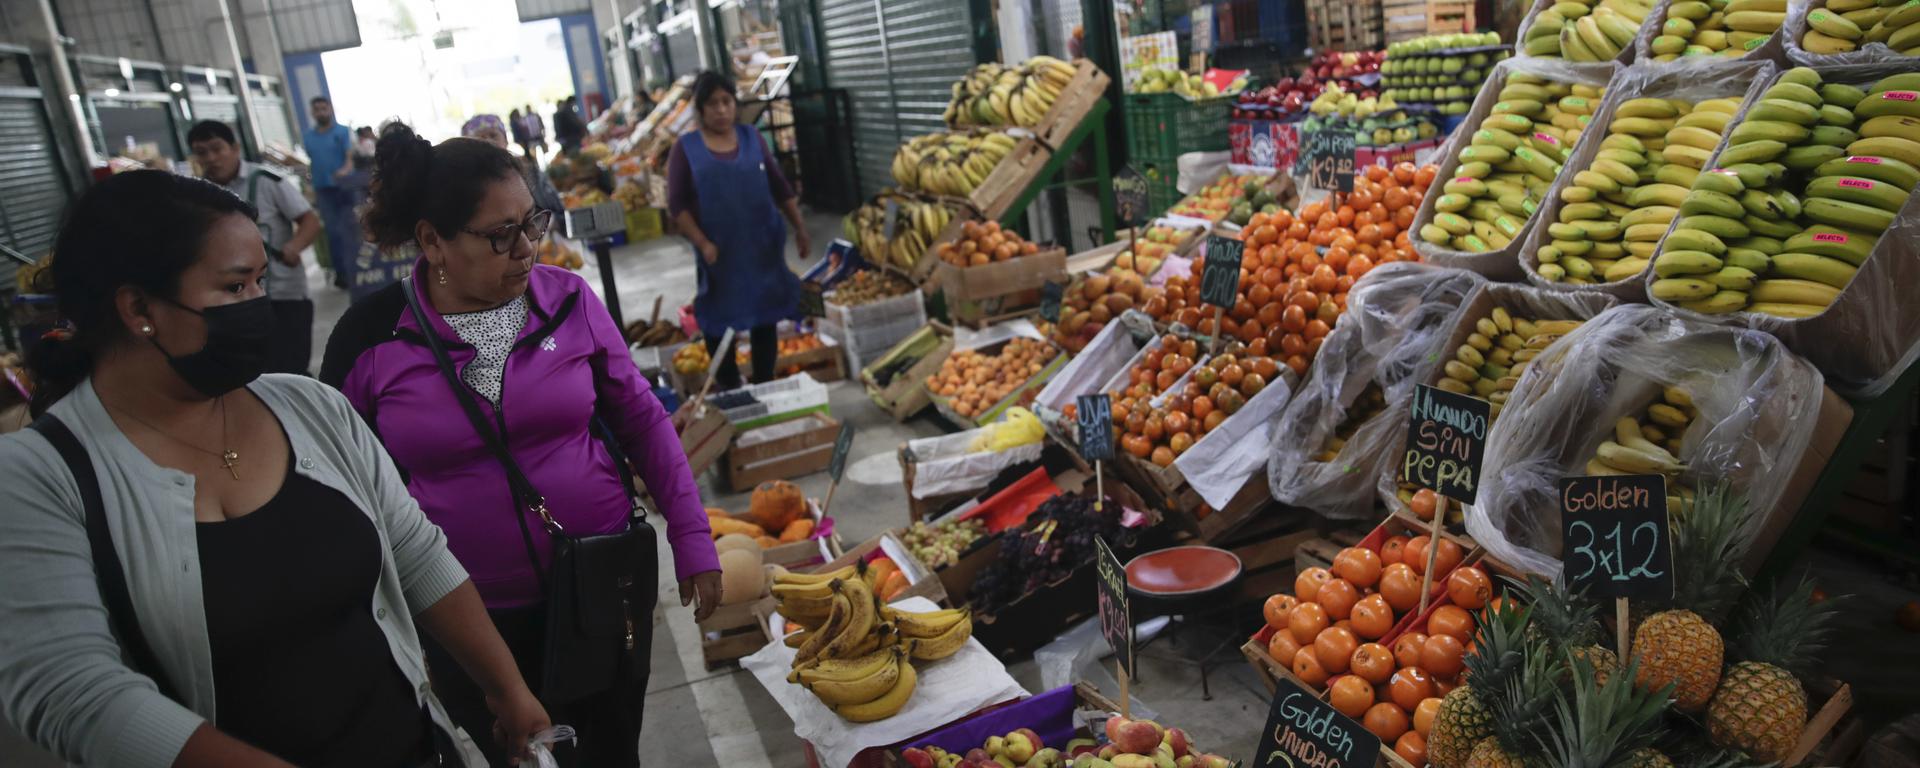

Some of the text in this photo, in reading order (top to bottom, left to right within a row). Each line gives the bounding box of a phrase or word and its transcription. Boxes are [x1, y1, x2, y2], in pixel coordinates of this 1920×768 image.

[1887, 92, 1915, 100] SELECTA
[1842, 180, 1870, 188] SELECTA
[1077, 396, 1110, 426] UVA
[1412, 385, 1485, 440] HUANDO
[1564, 479, 1649, 513] Golden
[1568, 520, 1664, 581] 3x12
[1280, 693, 1353, 761] Golden
